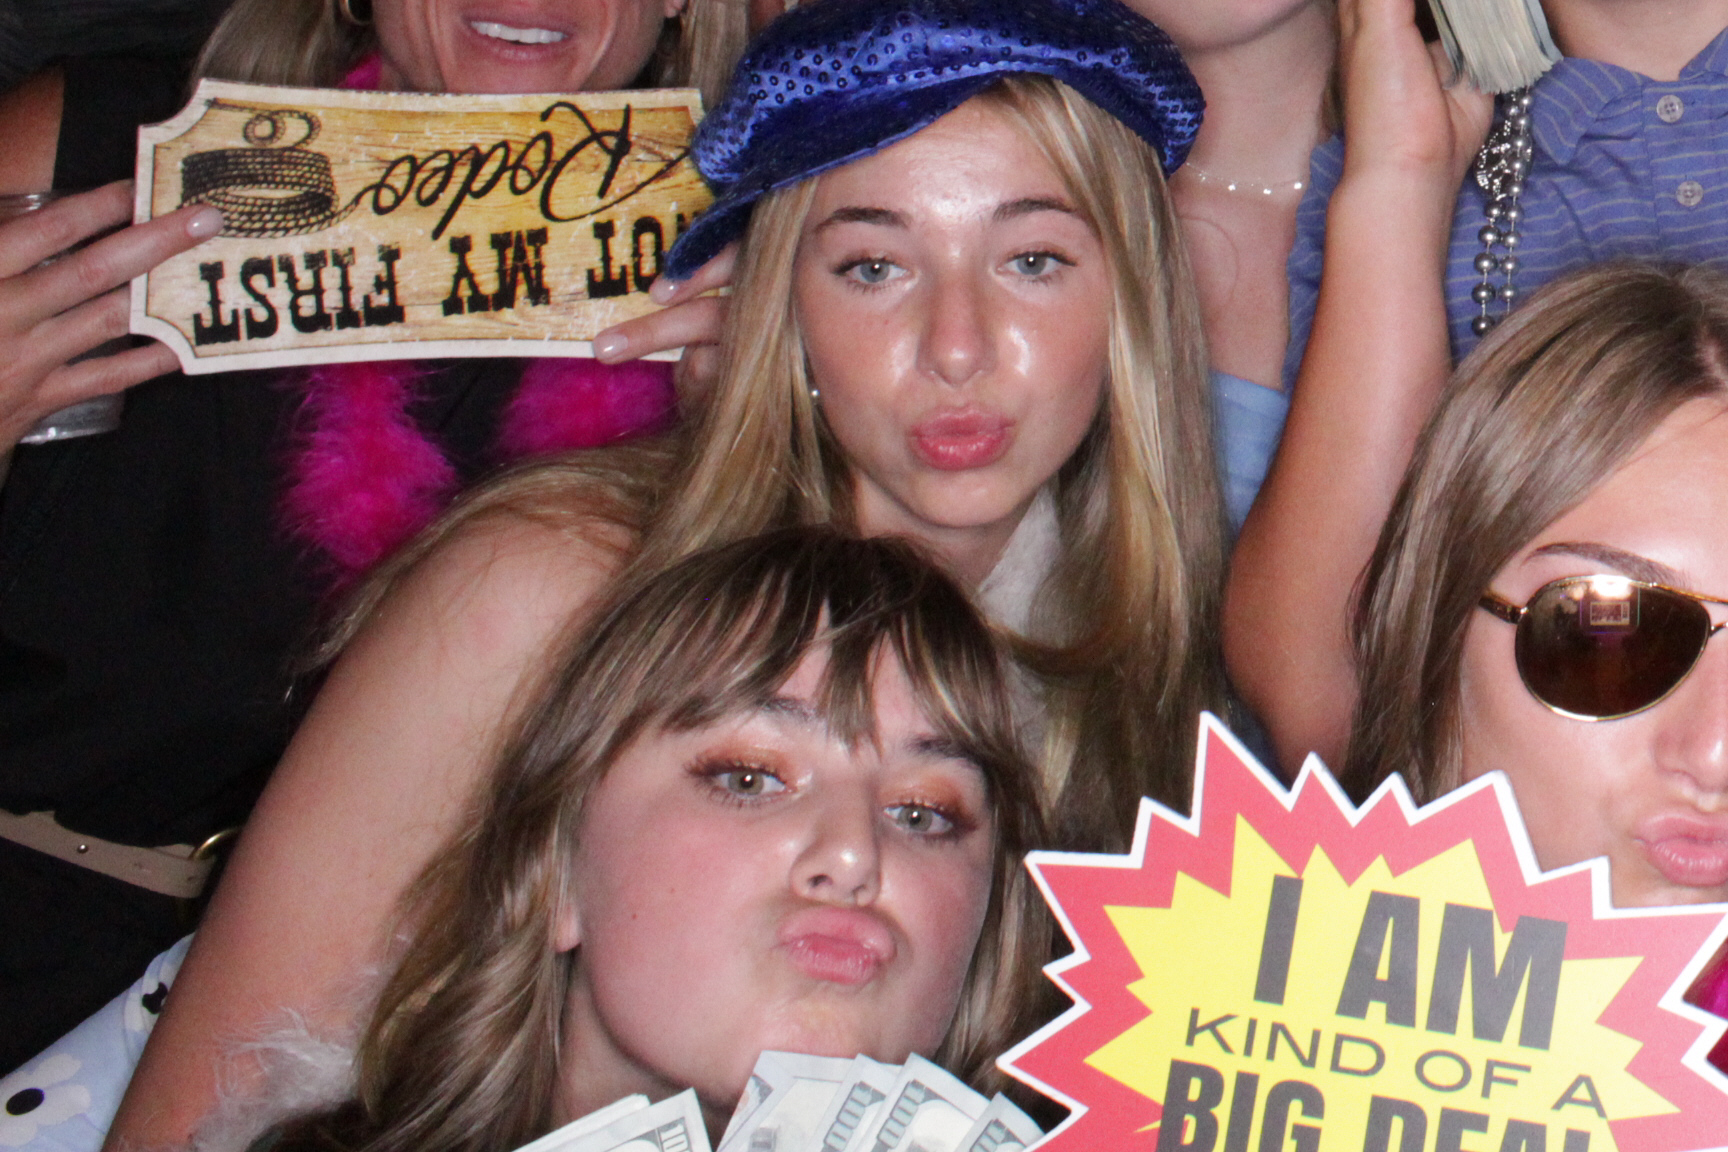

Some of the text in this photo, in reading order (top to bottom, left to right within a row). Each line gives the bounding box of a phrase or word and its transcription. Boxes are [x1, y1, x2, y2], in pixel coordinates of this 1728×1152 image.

[370, 100, 690, 240] Rodeo
[193, 208, 706, 346] OT MY FIRST
[1253, 874, 1569, 1052] I AM
[1155, 1059, 1326, 1152] BIG
[1184, 1007, 1607, 1120] KIND OF A
